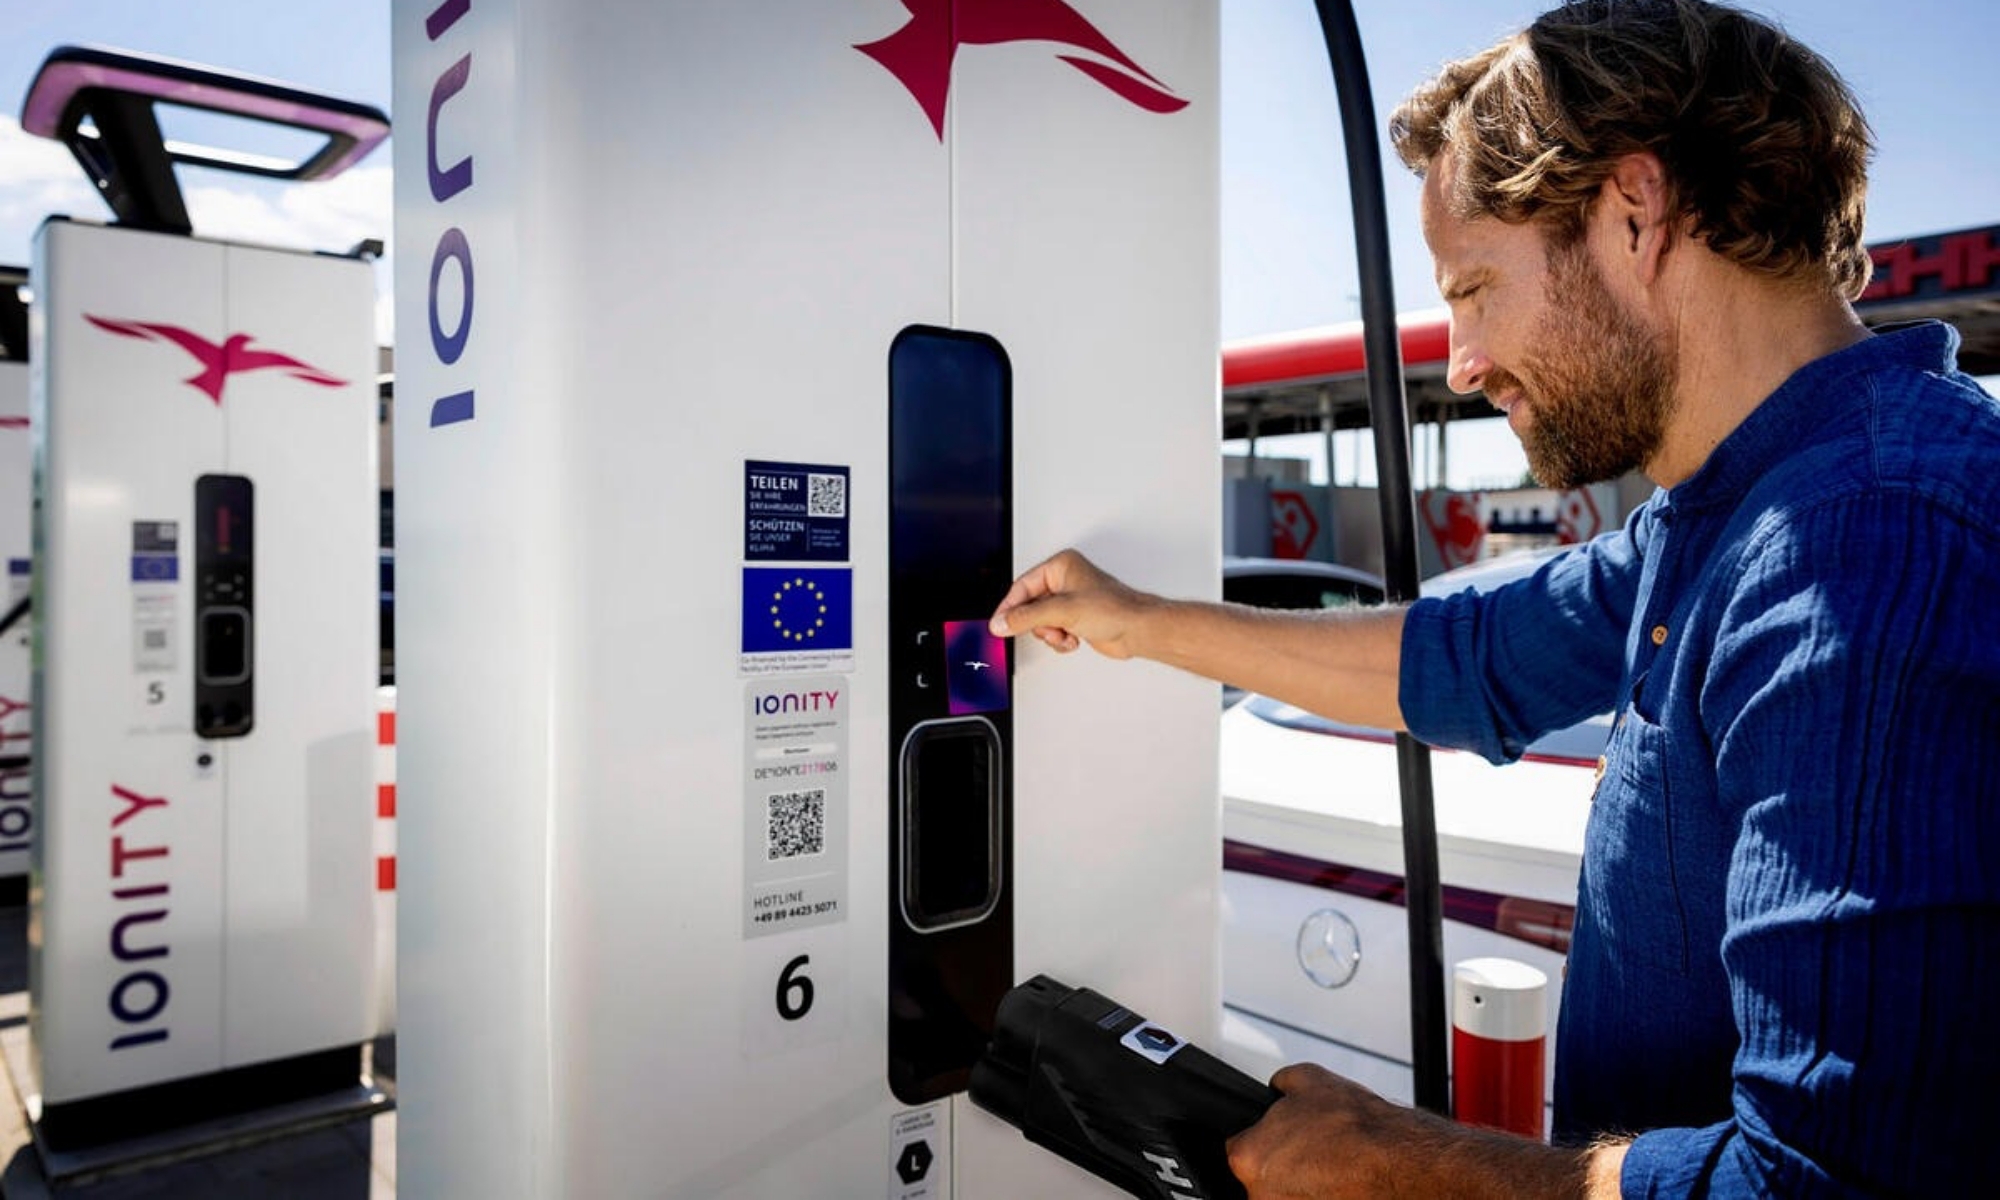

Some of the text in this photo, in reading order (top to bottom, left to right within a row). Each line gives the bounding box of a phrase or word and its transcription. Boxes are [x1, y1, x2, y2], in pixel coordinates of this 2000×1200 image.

[749, 475, 799, 491] TEILEN
[749, 518, 805, 531] SCHÜTZEN
[147, 681, 165, 706] 5
[755, 690, 839, 715] IONITY
[0, 695, 31, 854] IONTY
[754, 890, 803, 908] HOTLINE
[108, 783, 169, 1051] IONITY
[754, 911, 773, 922] +49
[776, 954, 814, 1021] 6
[911, 1154, 920, 1171] L
